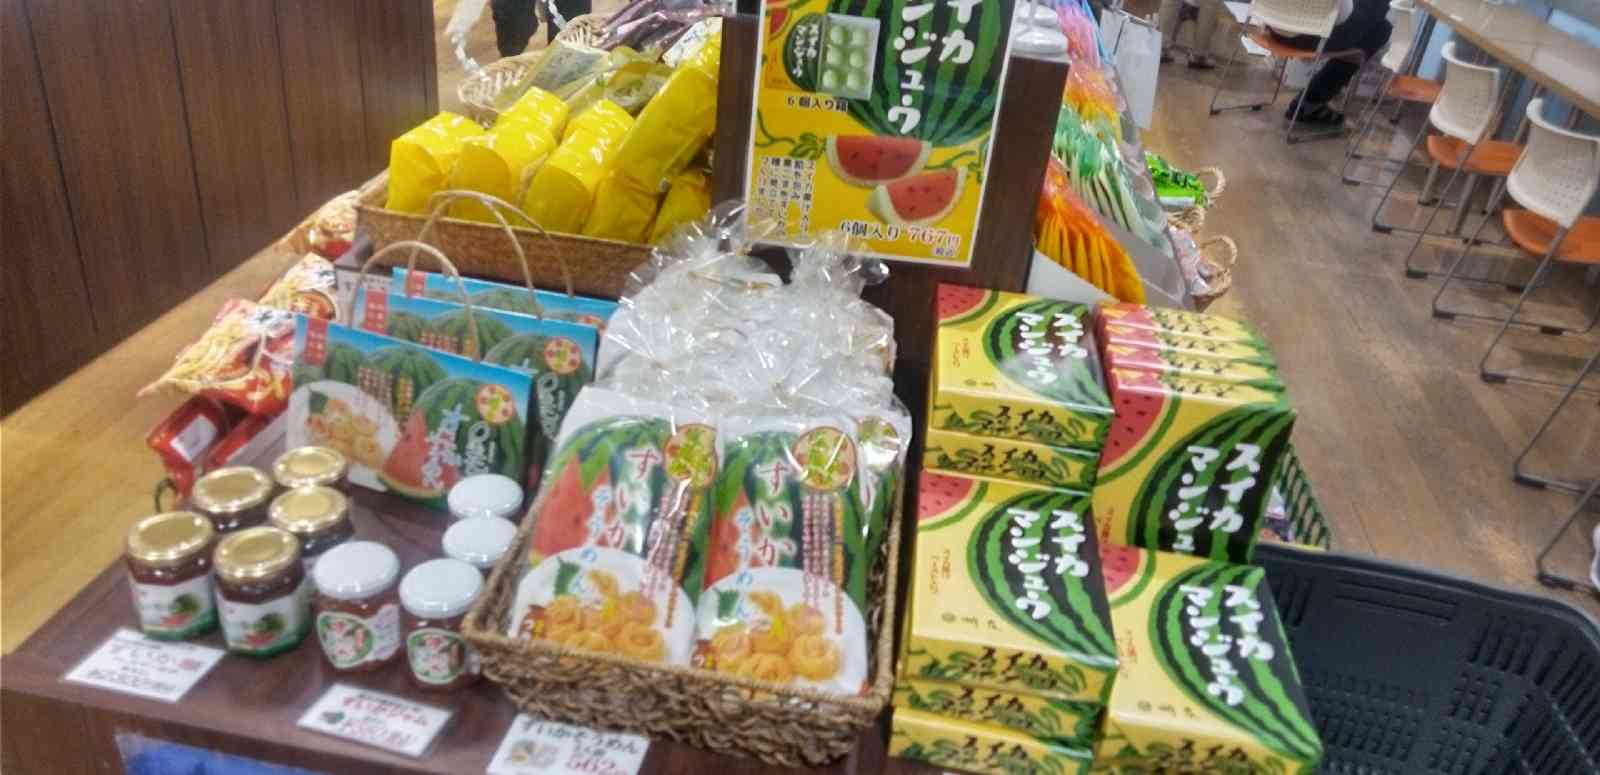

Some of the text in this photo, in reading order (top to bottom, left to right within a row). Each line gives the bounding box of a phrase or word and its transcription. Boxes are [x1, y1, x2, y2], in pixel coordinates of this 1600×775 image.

[840, 220, 900, 240] 6個入り
[1016, 312, 1057, 384] マンジュウ
[1053, 313, 1088, 359] スイカ
[751, 460, 797, 567] すいか
[1208, 443, 1262, 532] スイカ
[1007, 508, 1052, 620] マンジュウ
[1051, 509, 1090, 578] スイカ
[1179, 583, 1245, 706] マンジュウ
[1224, 585, 1275, 662] スイカ
